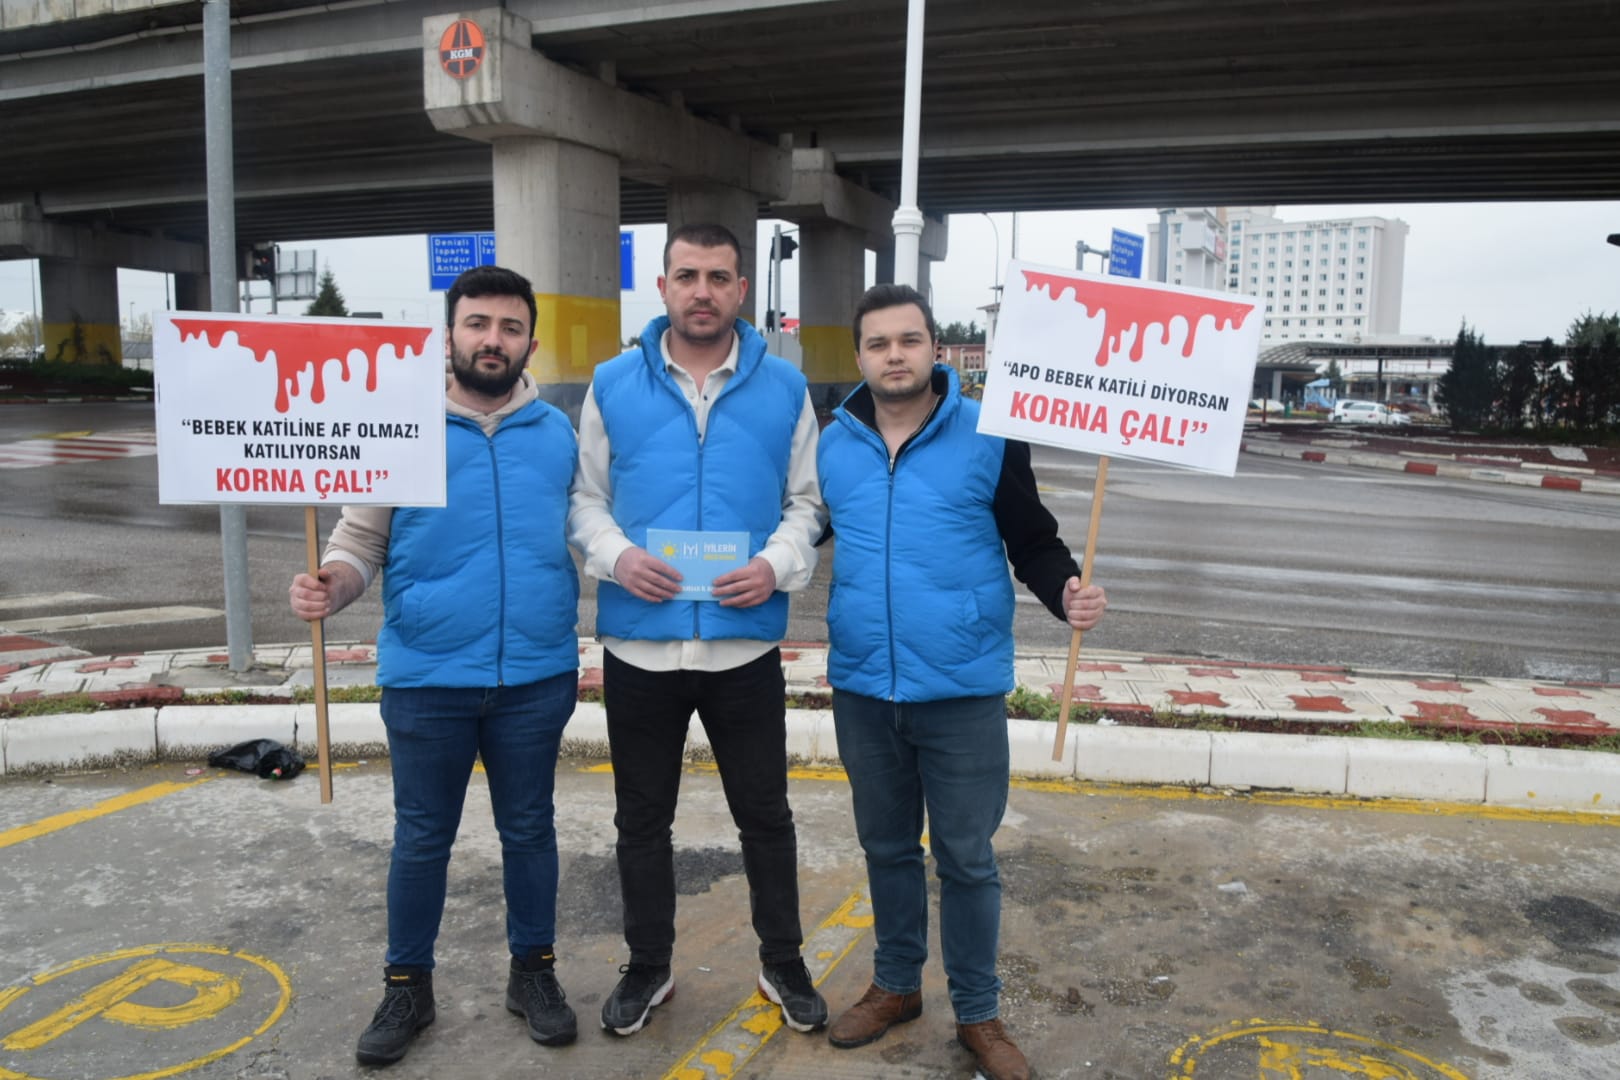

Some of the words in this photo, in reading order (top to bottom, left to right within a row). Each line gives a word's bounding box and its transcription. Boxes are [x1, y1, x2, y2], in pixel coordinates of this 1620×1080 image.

[450, 48, 473, 59] KGM
[434, 238, 470, 246] Denizli
[435, 247, 470, 255] Isparta
[435, 256, 470, 264] Burdur
[1003, 361, 1040, 381] “APO
[1045, 368, 1094, 390] BEBEK
[1098, 377, 1147, 398] KATİLİ
[1151, 384, 1230, 412] DİYORSAN
[181, 419, 247, 436] “BEBEK
[252, 417, 326, 437] KATİLİNE
[331, 422, 351, 437] AF
[357, 422, 419, 438] OLMAZ!
[1009, 391, 1108, 434] KORNA
[1119, 410, 1208, 447] ÇAL!”
[244, 443, 361, 460] KATILIYORSAN
[216, 467, 305, 492] KORNA
[314, 469, 389, 500] ÇAL!”
